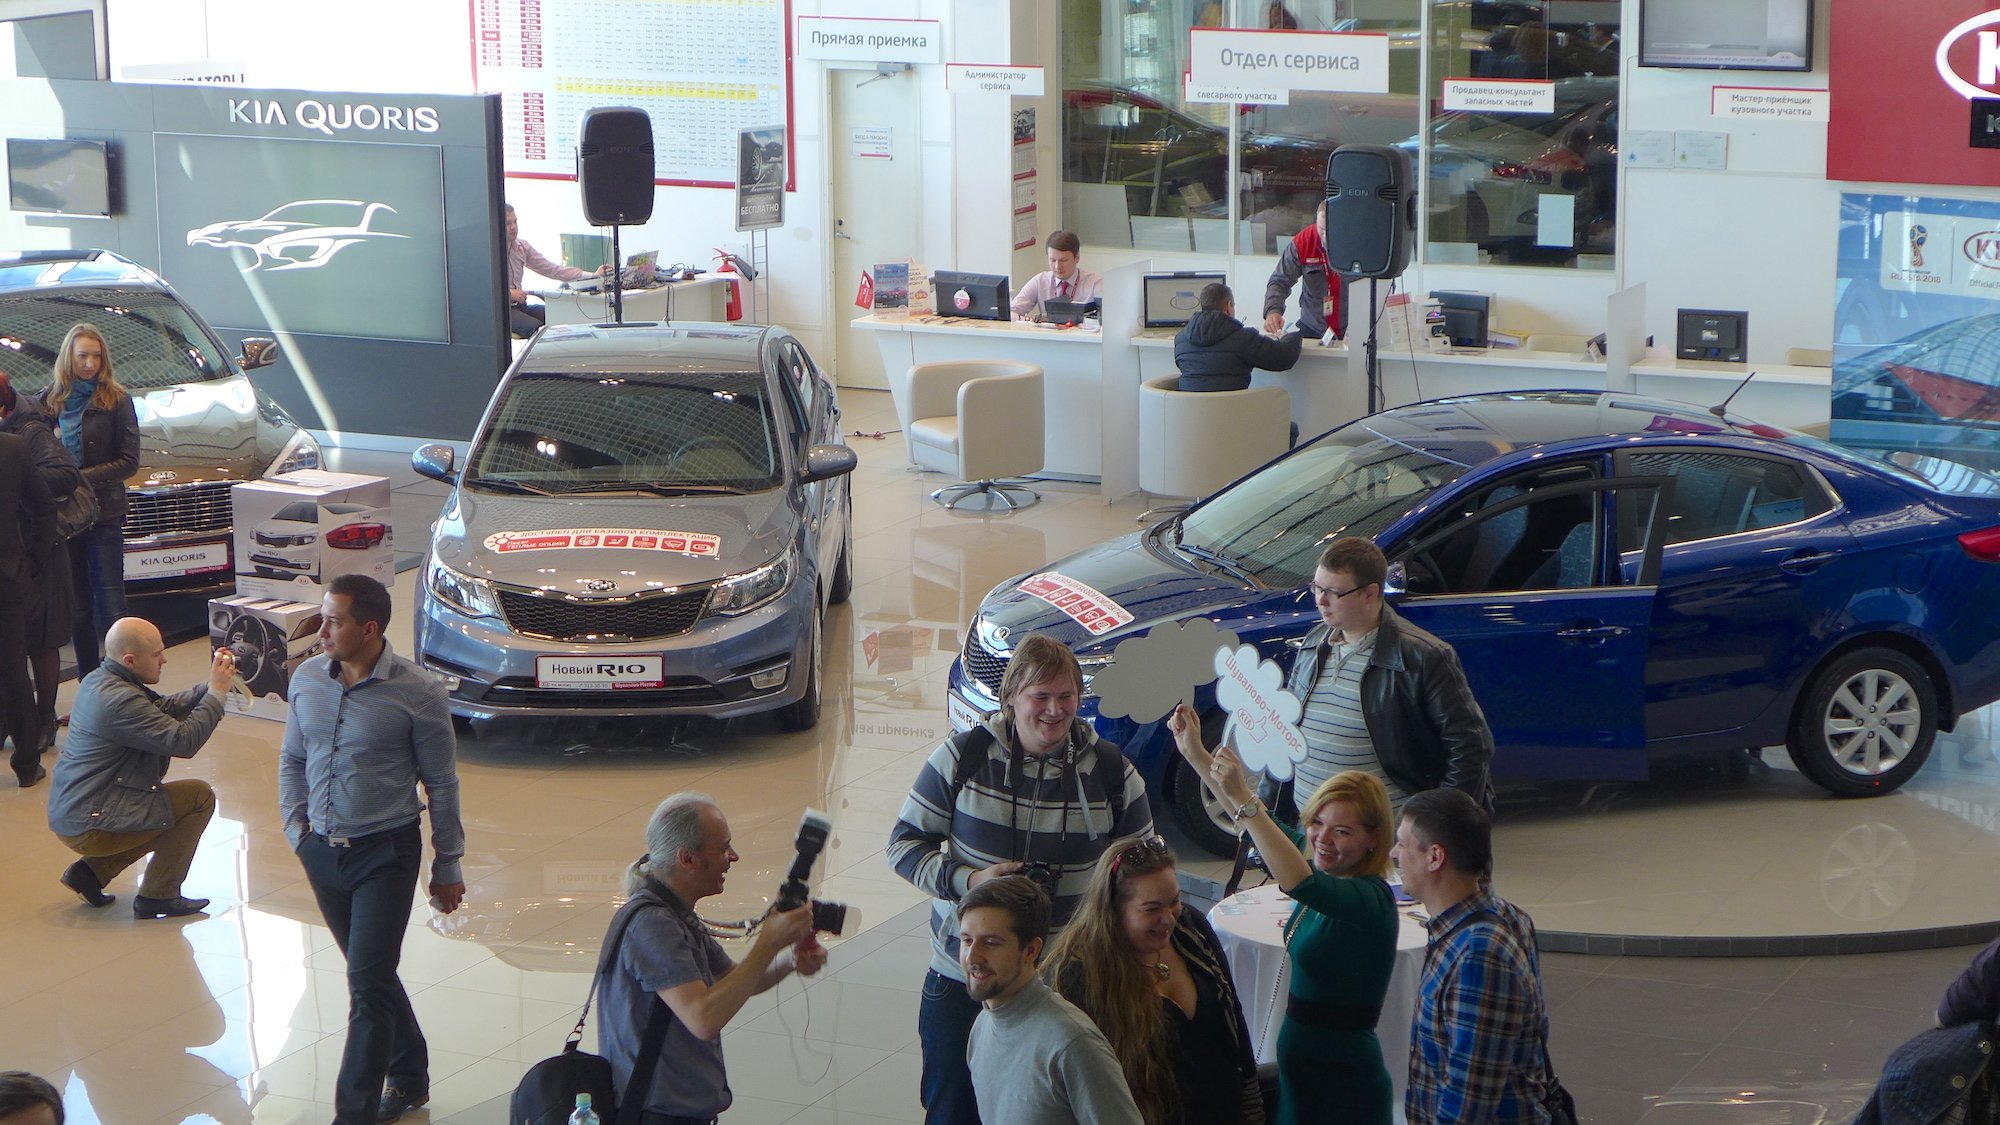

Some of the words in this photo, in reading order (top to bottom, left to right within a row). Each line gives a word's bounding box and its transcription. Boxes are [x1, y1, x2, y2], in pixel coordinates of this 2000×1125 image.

[812, 31, 864, 47] Прямая
[868, 35, 927, 48] приемка
[1221, 48, 1278, 69] Отдел
[1284, 53, 1360, 73] сервиса
[965, 70, 1026, 80] Администратор
[980, 81, 1011, 90] сервиса
[1452, 85, 1546, 96] Продавец-консультант
[1197, 91, 1243, 100] слесарного
[1244, 92, 1277, 101] участка
[1464, 97, 1503, 106] запасных
[1505, 98, 1533, 106] частей
[1731, 94, 1812, 104] Мастер-приёмщик
[228, 98, 288, 125] KIA
[295, 100, 440, 135] QUORIS
[1731, 106, 1775, 115] кузовного
[1777, 107, 1812, 116] участка
[1348, 188, 1369, 197] EON
[741, 203, 779, 216] БЕСПЛАТНО
[639, 530, 718, 541] КОМПЛЕКТАЦИИ
[141, 557, 159, 566] KIA
[162, 552, 206, 564] QUORIS
[552, 664, 593, 675] Новый
[597, 664, 646, 677] RIO
[1225, 655, 1302, 752] Шувалово-Моторс
[1239, 711, 1254, 728] KIA
[1067, 742, 1075, 764] SONY
